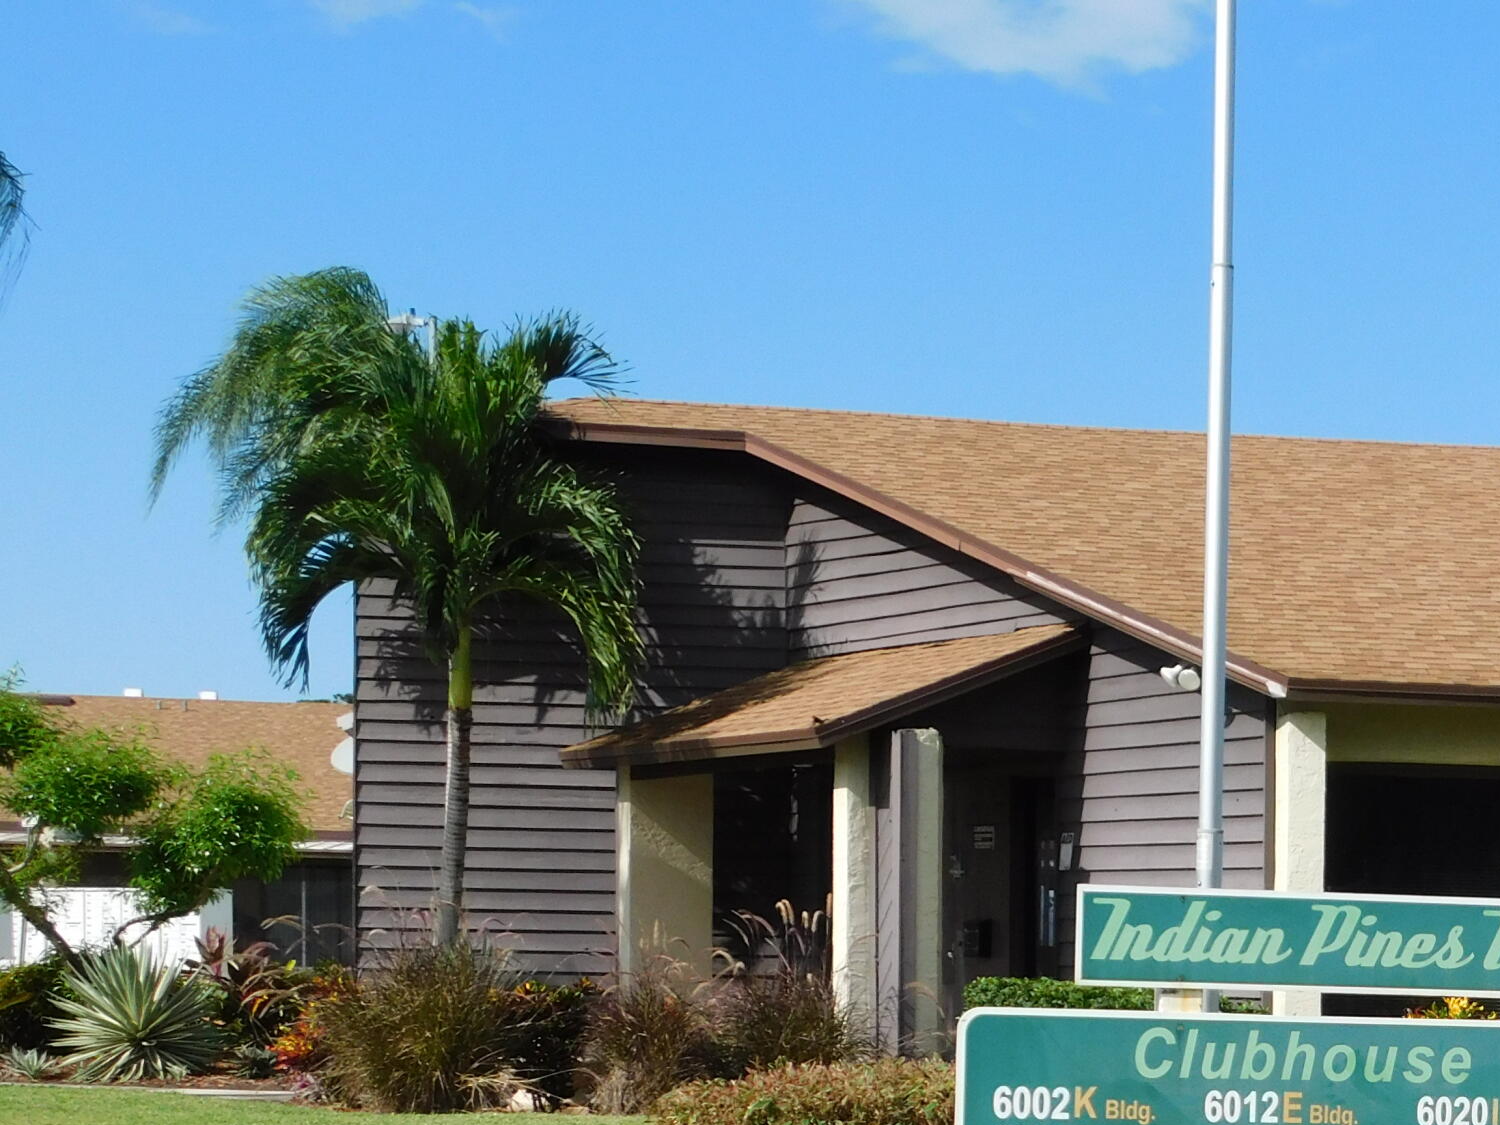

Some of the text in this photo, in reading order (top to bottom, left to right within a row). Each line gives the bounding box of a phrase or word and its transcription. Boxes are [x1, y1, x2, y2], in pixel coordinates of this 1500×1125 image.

[1090, 898, 1293, 965] Indian
[1299, 904, 1475, 970] Pines
[1134, 1027, 1472, 1084] Clubhouse
[1105, 1100, 1156, 1125] Bldg.
